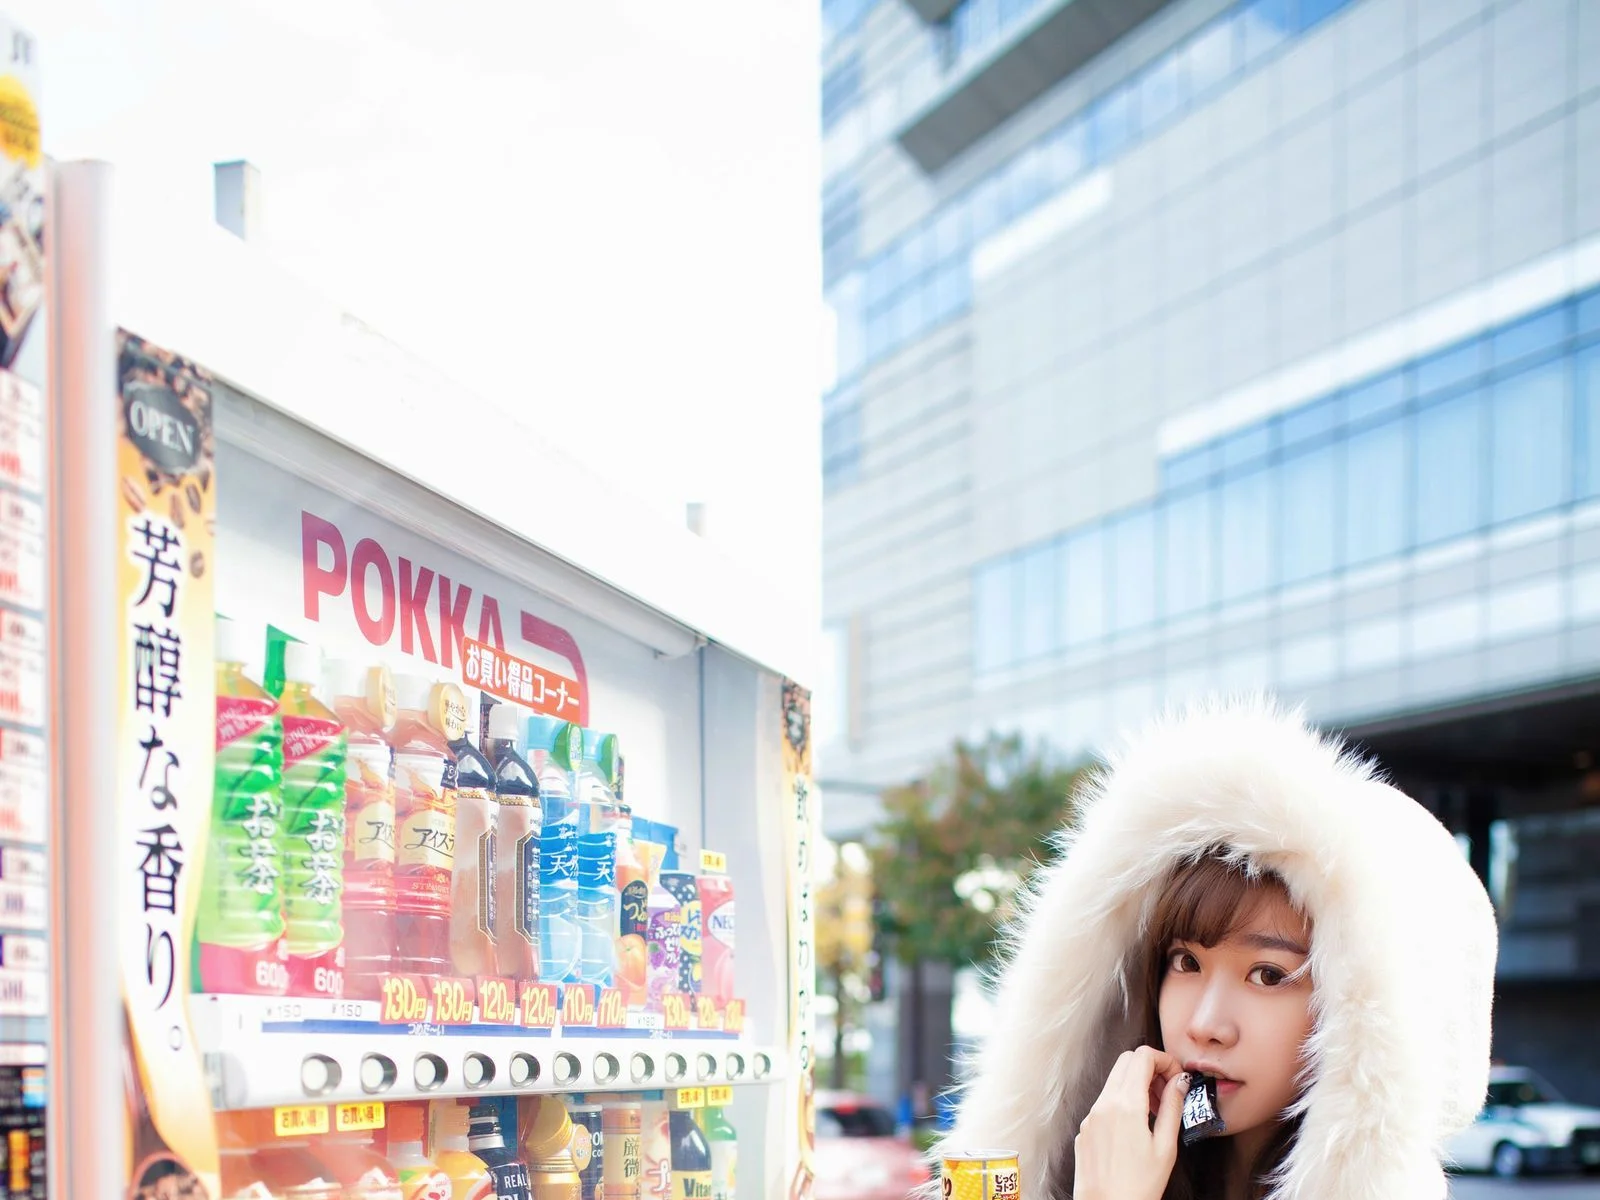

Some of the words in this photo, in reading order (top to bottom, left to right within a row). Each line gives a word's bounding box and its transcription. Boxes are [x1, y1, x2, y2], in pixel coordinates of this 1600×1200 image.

[130, 400, 195, 456] OPEN
[302, 510, 506, 670] POKKA
[466, 644, 580, 713] お買い得品コーナー
[132, 517, 184, 1052] 芳醇な香り。
[382, 978, 427, 1020] 130円
[433, 979, 473, 1022] 130円
[479, 980, 514, 1020] 120円
[524, 986, 555, 1026] 120円
[1190, 1086, 1212, 1124] 男梅
[504, 1173, 527, 1189] REAL
[995, 1172, 1018, 1185] じっくり
[995, 1182, 1018, 1194] コトコト
